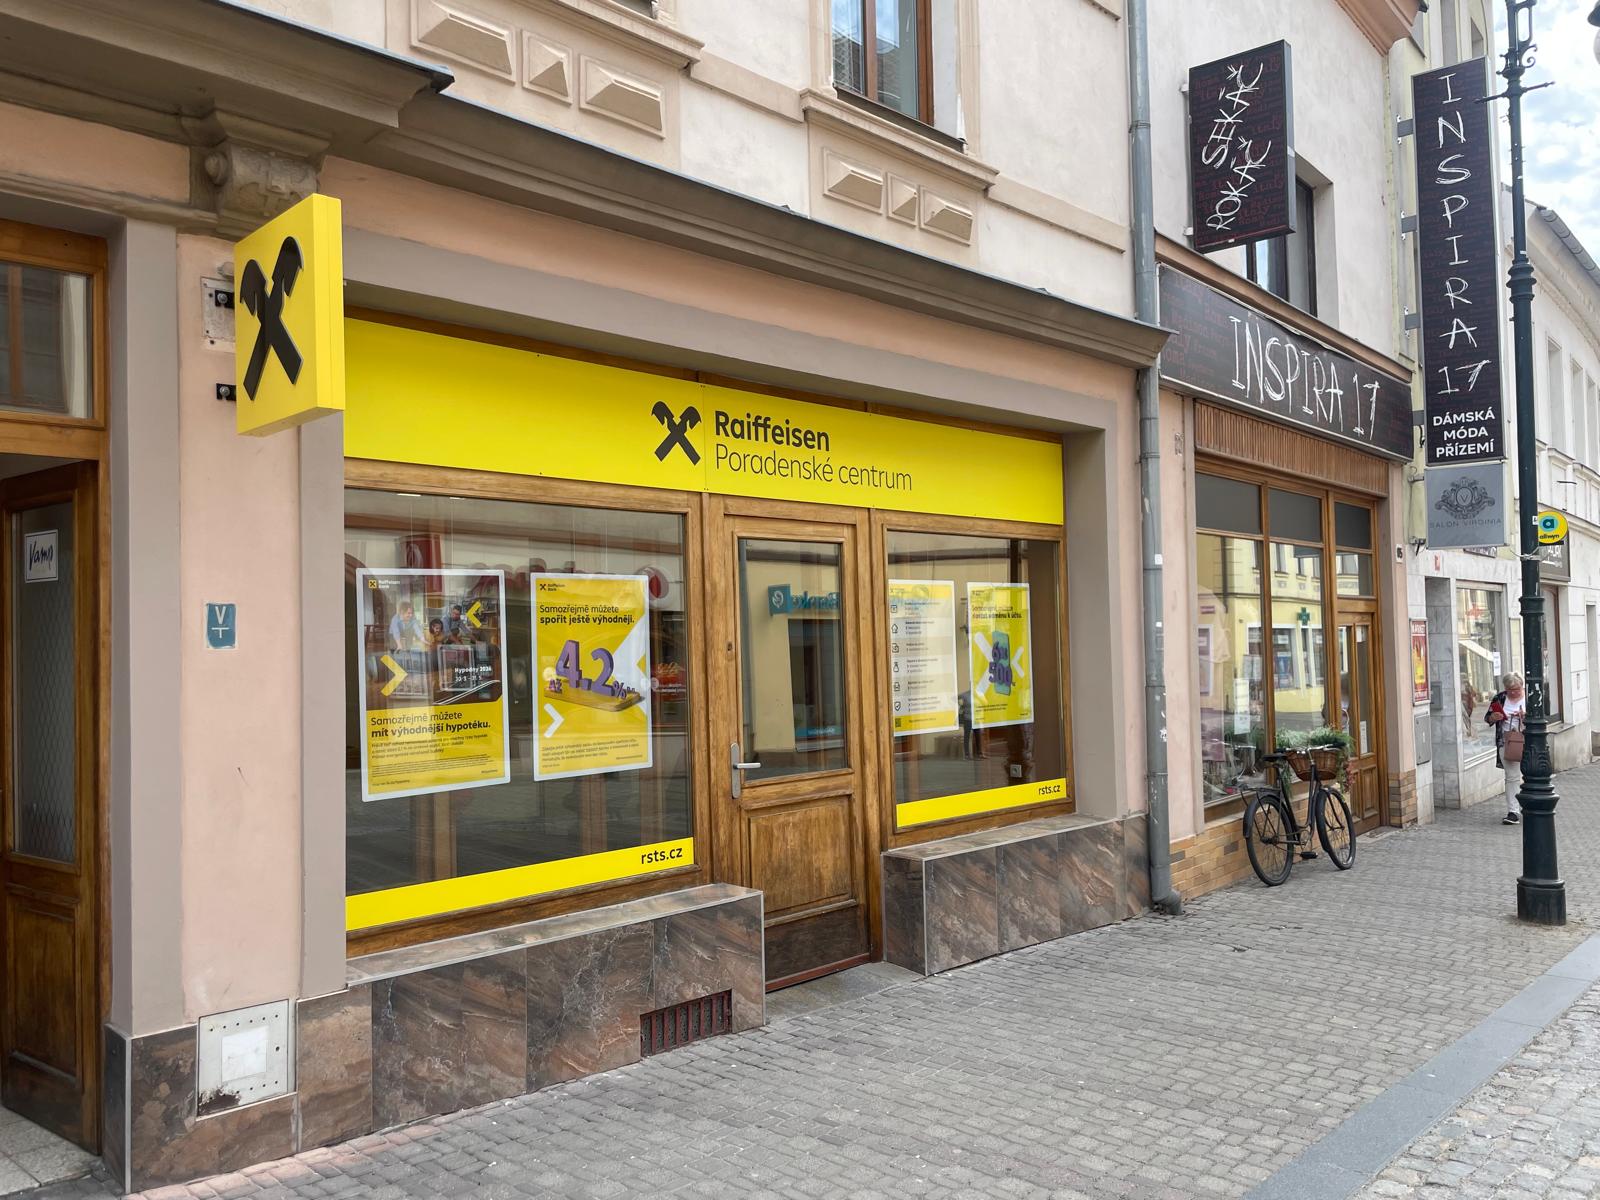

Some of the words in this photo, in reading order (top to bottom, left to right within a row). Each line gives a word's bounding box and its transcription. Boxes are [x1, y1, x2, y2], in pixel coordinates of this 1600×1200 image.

[1202, 62, 1263, 169] SEKÁČ
[1206, 136, 1271, 230] ROKÁČ
[1436, 73, 1478, 349] INSPIRA
[1229, 316, 1344, 432] INSPIRA
[1353, 372, 1381, 440] 17
[1437, 359, 1492, 395] 17
[1433, 407, 1496, 426] DÁMSKÁ
[715, 410, 830, 452] Raiffeisen
[1443, 426, 1489, 441] MÓDA
[1436, 439, 1494, 458] PŘÍZEMÍ
[716, 443, 834, 482] Poradenské
[838, 465, 912, 491] centrum
[1429, 521, 1460, 529] SALON
[1463, 518, 1502, 528] VIRGINIA
[214, 605, 227, 625] V
[540, 604, 589, 615] Samozřejmě
[590, 604, 619, 613] můžete
[540, 614, 567, 625] spořit
[568, 614, 590, 625] ještě
[592, 614, 636, 625] výhodněji.
[371, 713, 428, 726] Samozřejmě
[430, 711, 463, 721] můžete
[371, 727, 389, 738] mít
[391, 723, 444, 738] výhodnější
[445, 720, 491, 733] hypotéku.
[1038, 784, 1061, 796] rsts.cz
[641, 847, 683, 865] rsts.cz
